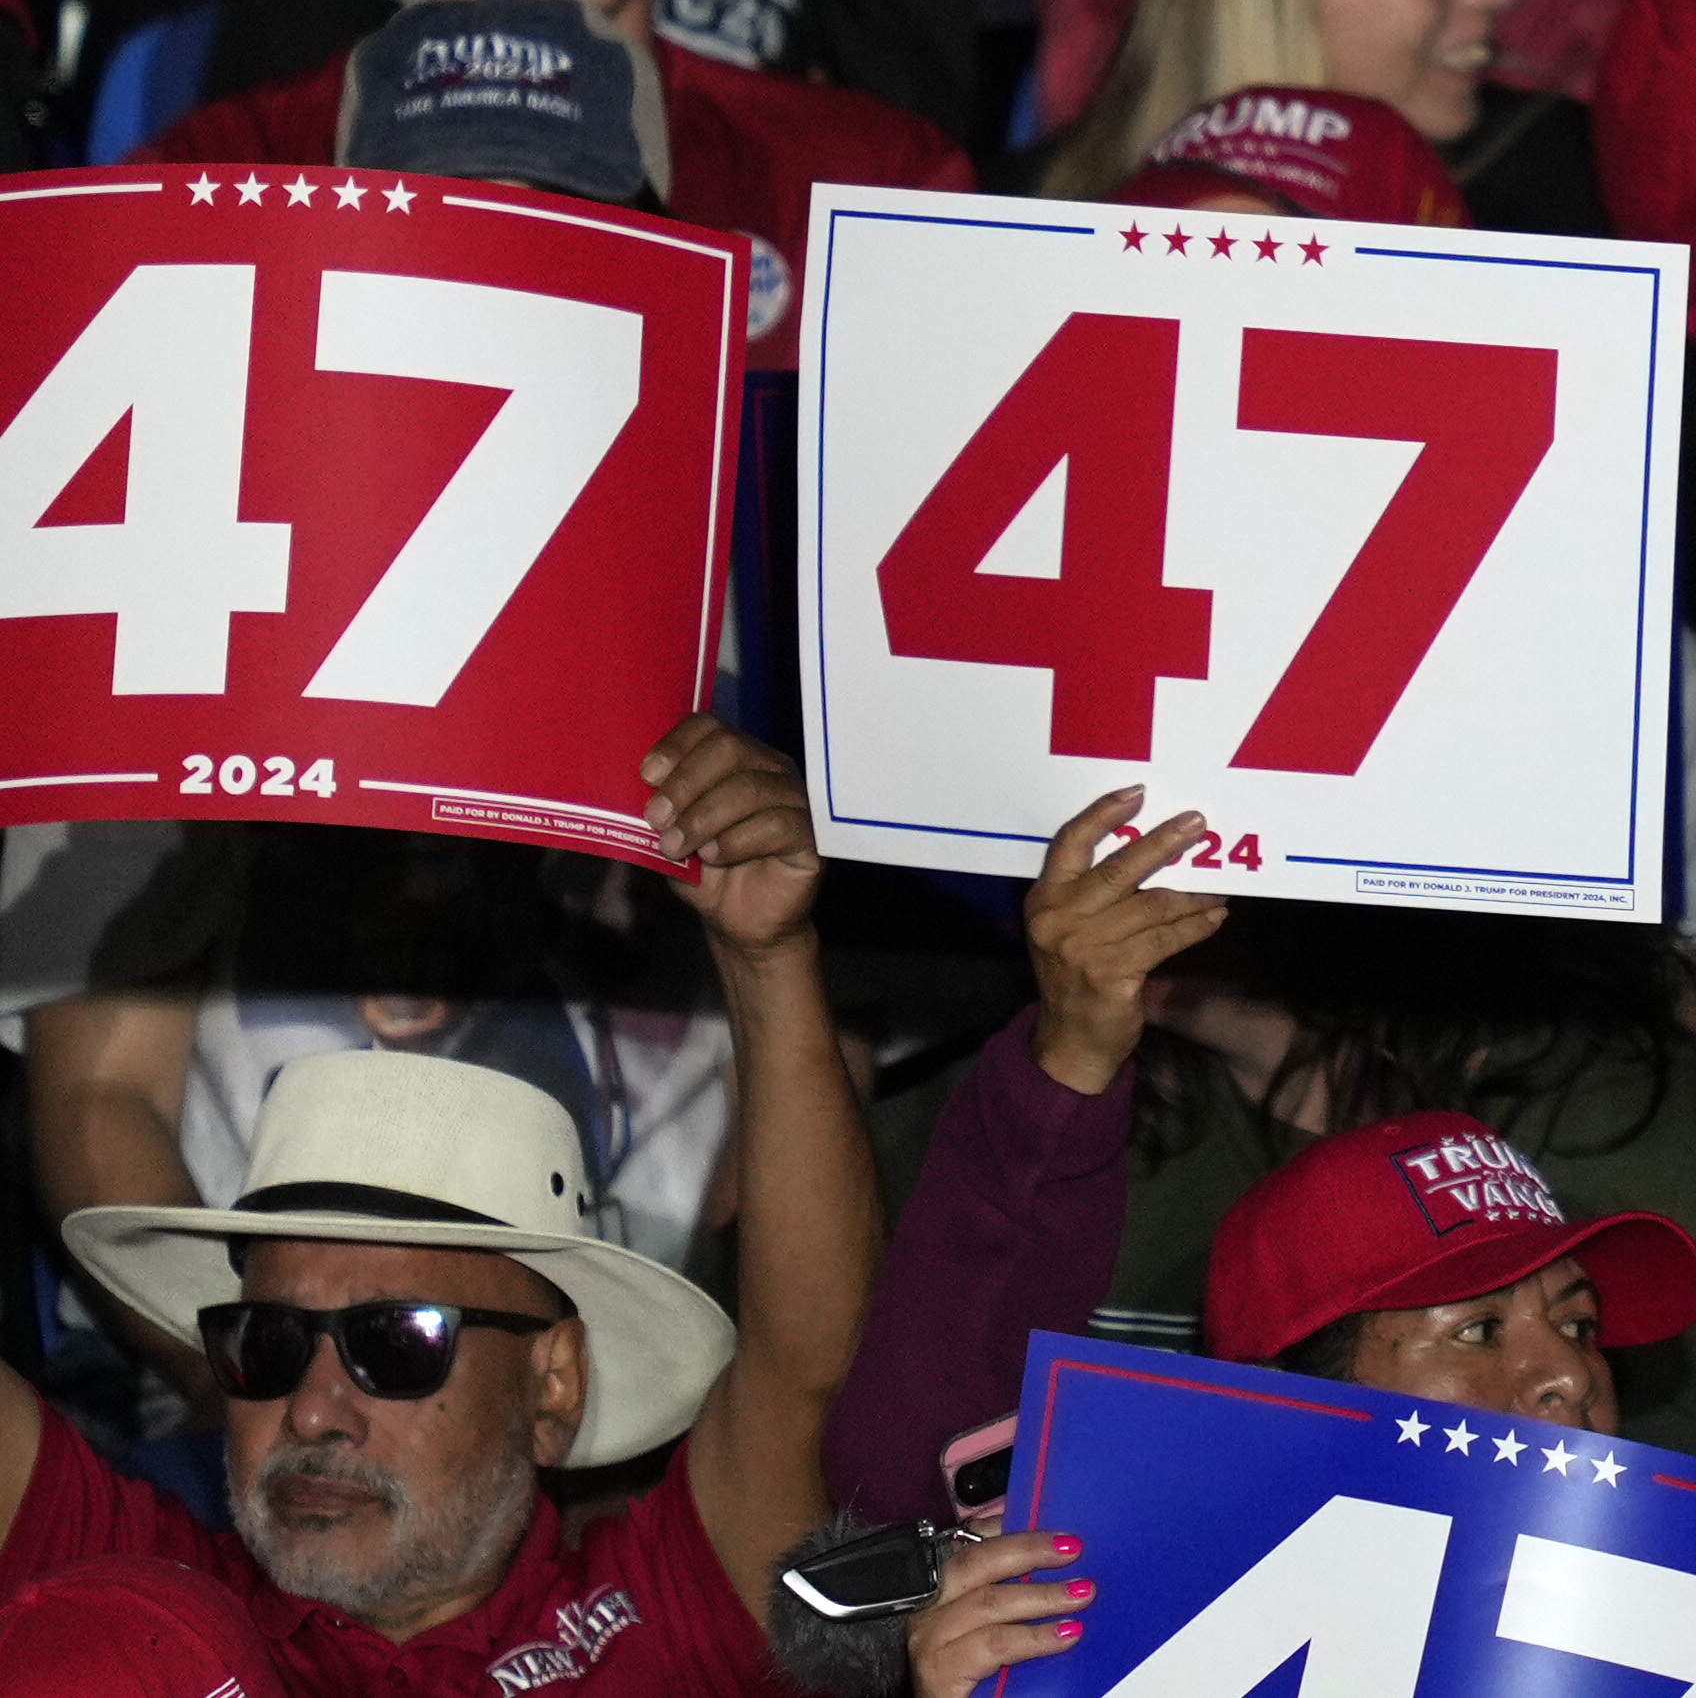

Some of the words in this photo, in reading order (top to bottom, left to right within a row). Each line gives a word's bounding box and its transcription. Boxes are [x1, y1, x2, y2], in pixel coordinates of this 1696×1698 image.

[1151, 96, 1353, 163] TRUMP
[0, 264, 643, 707] 47
[875, 311, 1558, 776] 47
[179, 755, 337, 798] 2024
[440, 805, 464, 815] PAID
[465, 806, 485, 818] FOR
[487, 809, 500, 819] BY
[502, 811, 542, 825] DONALD
[553, 818, 584, 832] TRUMP
[586, 823, 605, 835] FOR
[606, 828, 650, 847] PRESIDENT
[1363, 878, 1386, 887] PAID
[1388, 879, 1407, 889] FOR
[1409, 881, 1421, 890] BY
[1423, 882, 1462, 893] DONALD
[1464, 884, 1472, 894] J.
[1474, 886, 1507, 895] TRUMP
[1509, 888, 1528, 897] FOR
[1530, 890, 1581, 901] PRESIDENT
[1583, 893, 1607, 903] 2024,
[1609, 895, 1628, 904] INC.
[1406, 1139, 1551, 1195] TRUM
[491, 1650, 576, 1698] NEW
